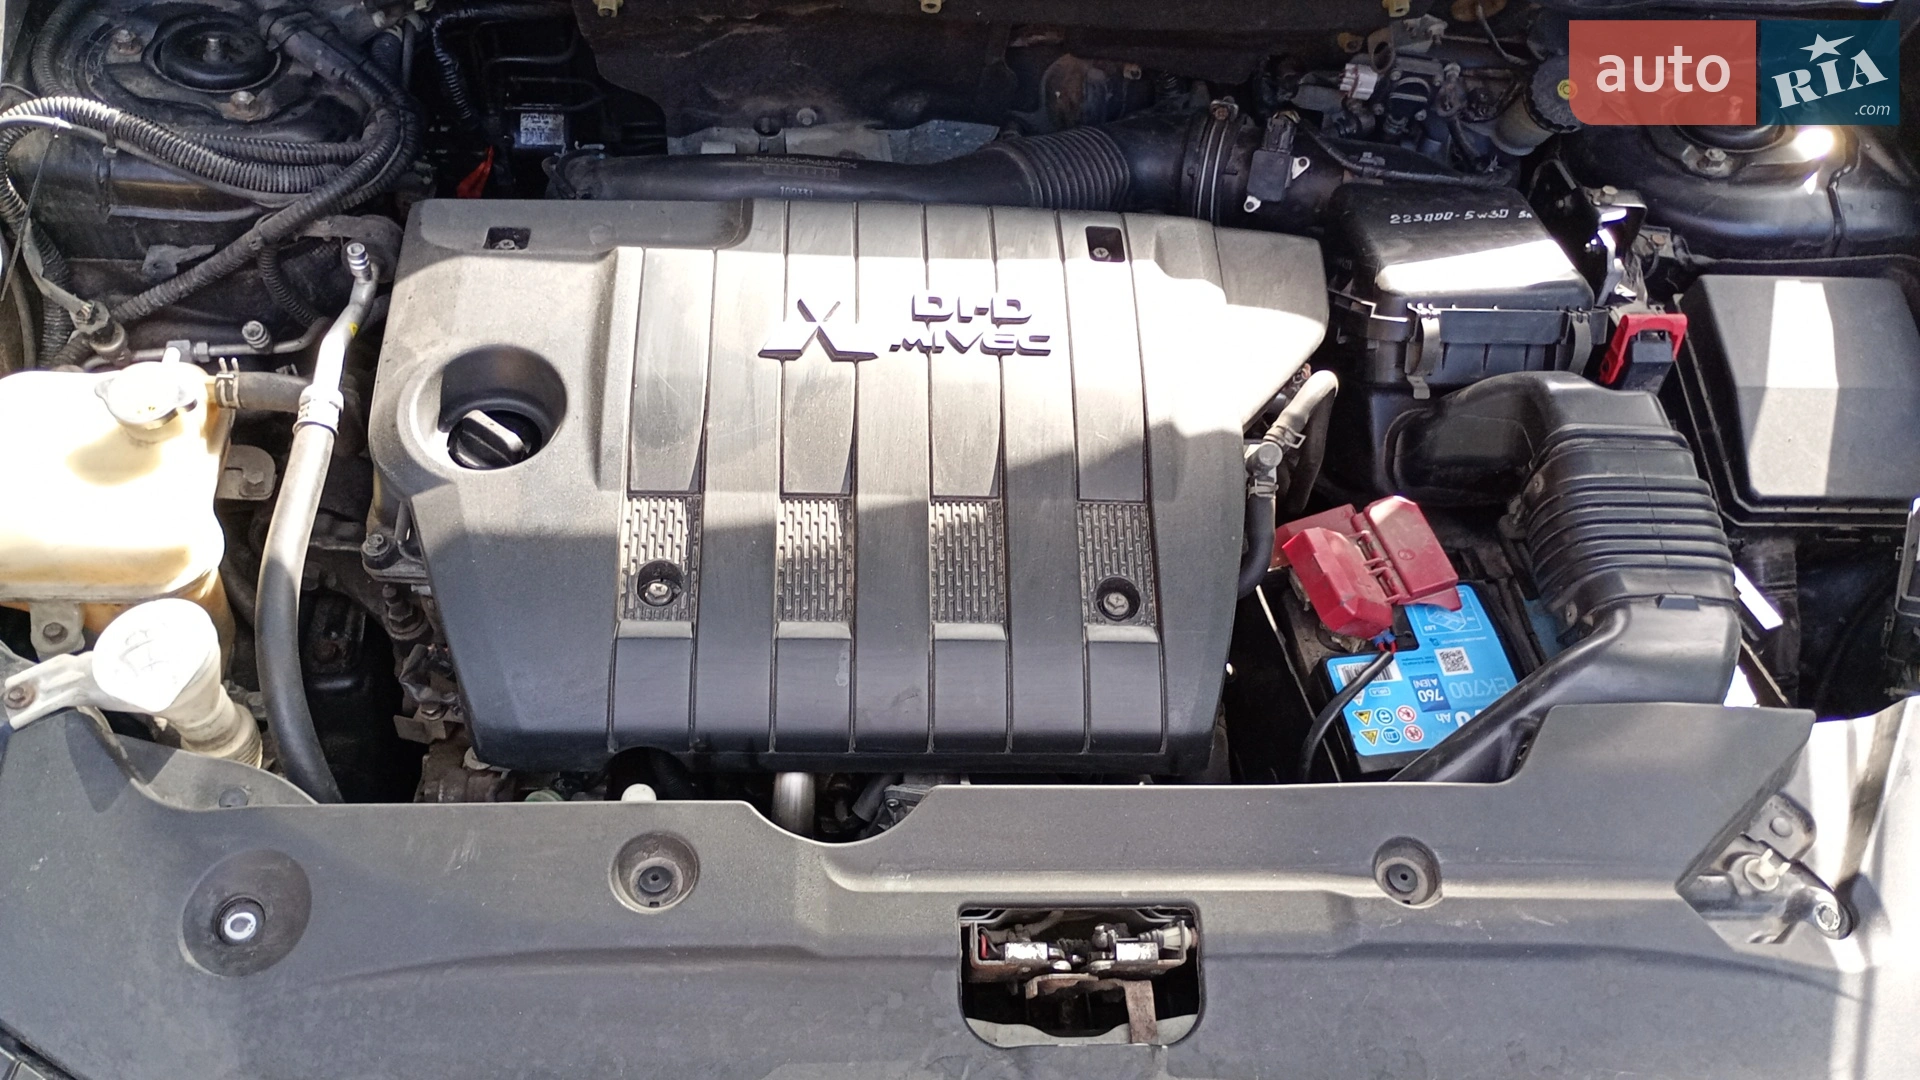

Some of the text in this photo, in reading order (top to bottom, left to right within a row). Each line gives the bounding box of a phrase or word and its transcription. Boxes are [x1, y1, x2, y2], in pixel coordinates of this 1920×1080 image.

[911, 294, 1033, 325] DI-D
[888, 329, 1052, 357] MIVEC
[1417, 689, 1444, 703] 760
[1451, 677, 1509, 699] EK700
[1435, 709, 1482, 727] 0 Ah
